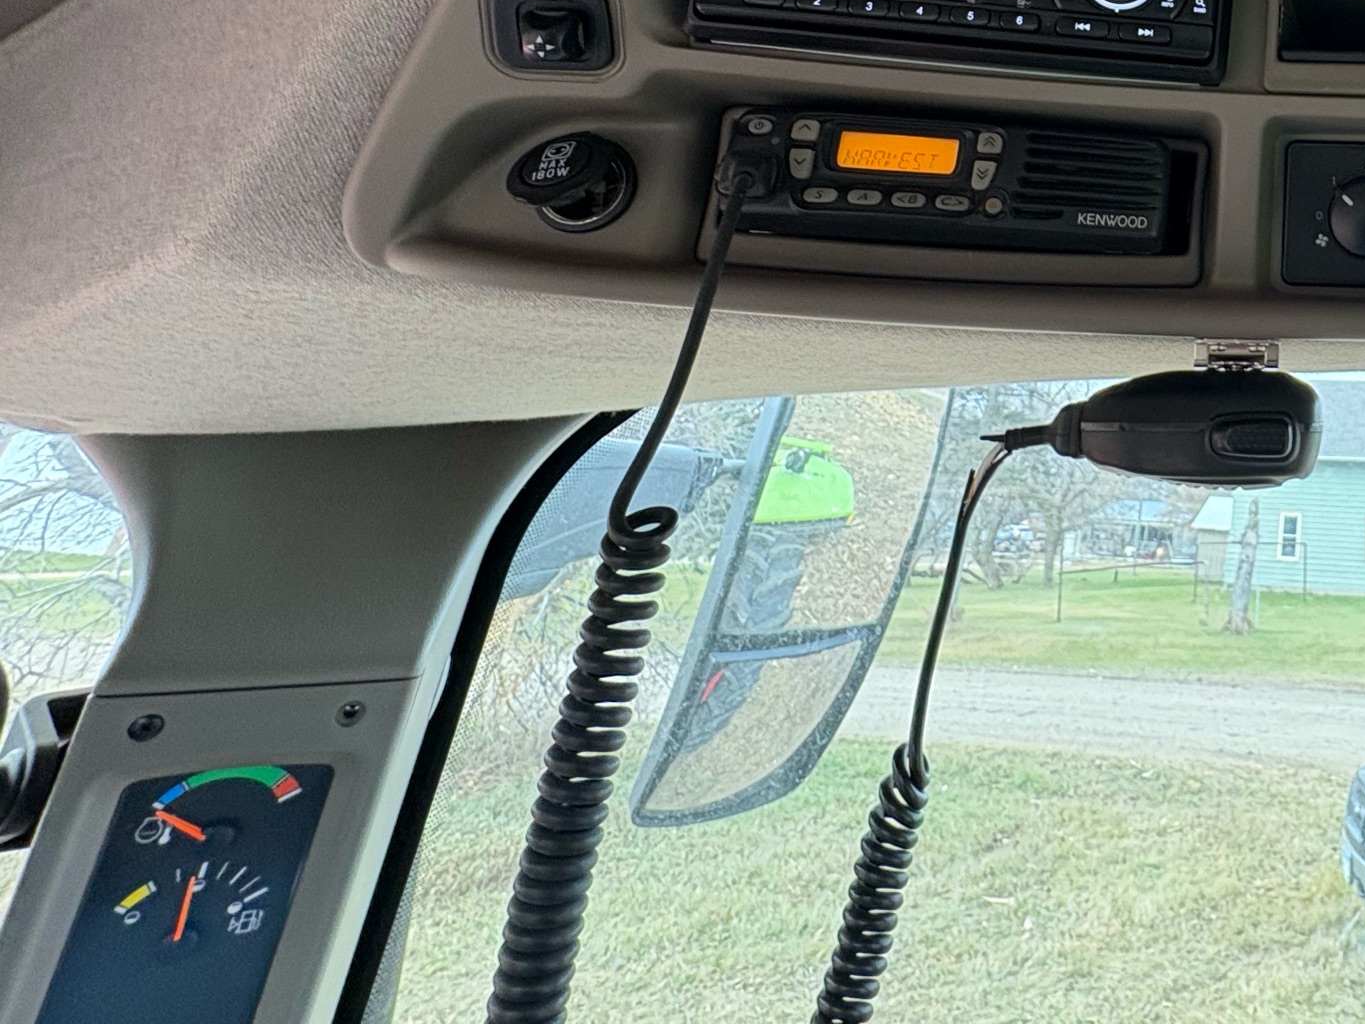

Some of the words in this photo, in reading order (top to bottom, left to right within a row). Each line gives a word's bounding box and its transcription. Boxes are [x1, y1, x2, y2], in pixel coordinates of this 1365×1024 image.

[865, 1, 873, 11] 3
[916, 6, 924, 16] 4
[966, 11, 975, 21] 5
[1016, 16, 1024, 25] 6
[538, 159, 568, 170] MAX
[531, 167, 571, 181] 180W
[814, 190, 824, 199] S
[856, 192, 869, 202] A
[1077, 212, 1148, 229] KENWOOD
